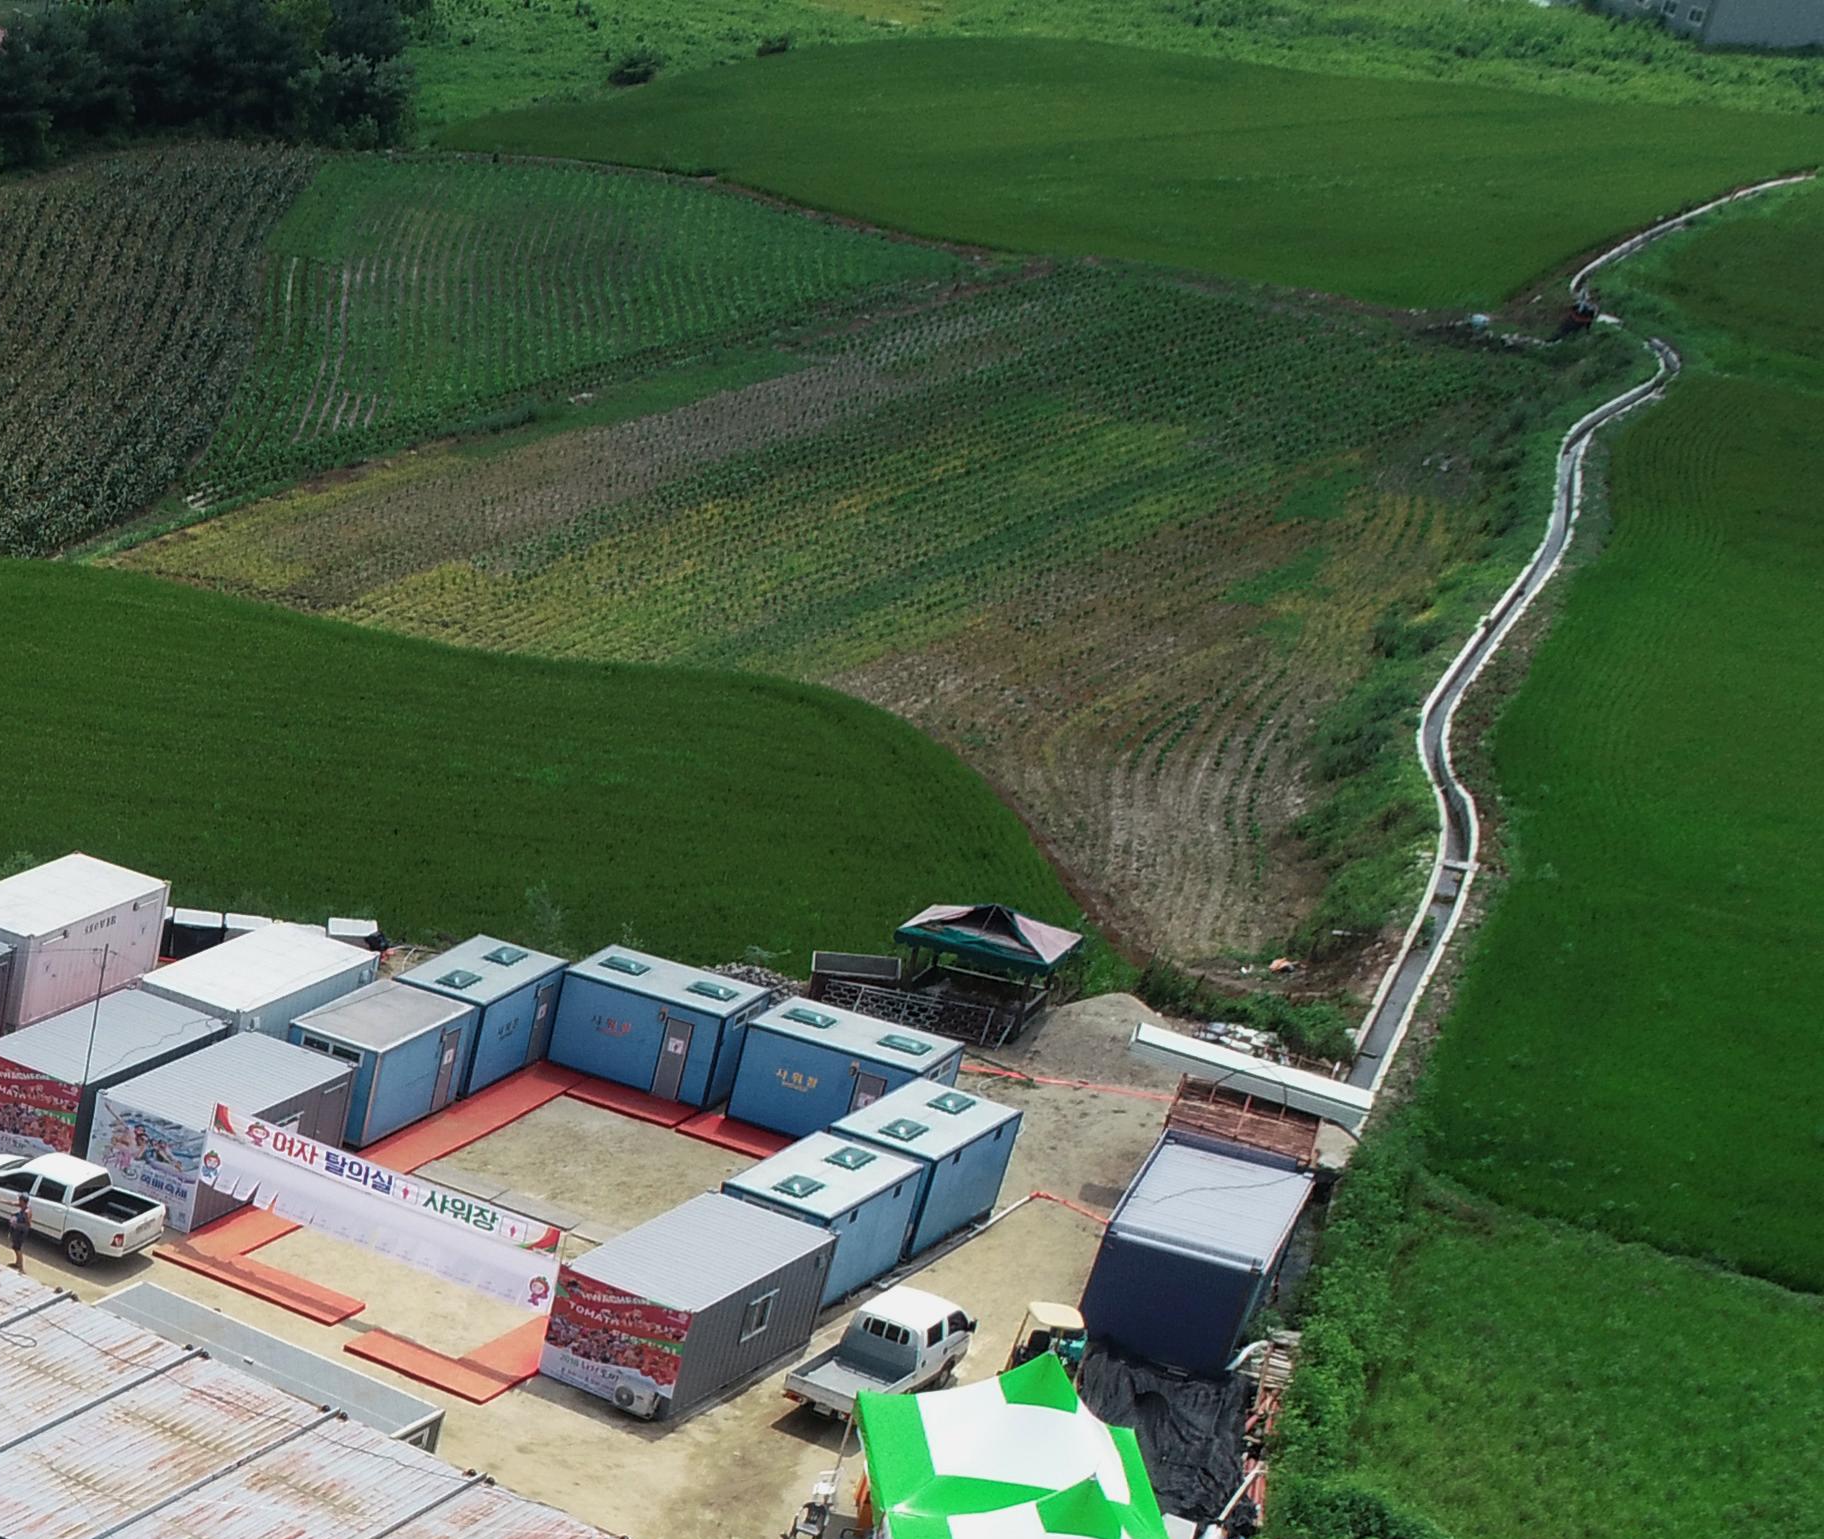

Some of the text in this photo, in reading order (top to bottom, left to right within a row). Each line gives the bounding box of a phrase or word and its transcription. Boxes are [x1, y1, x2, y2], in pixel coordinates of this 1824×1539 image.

[272, 1131, 499, 1232] 여자 탈의실 샤워장
